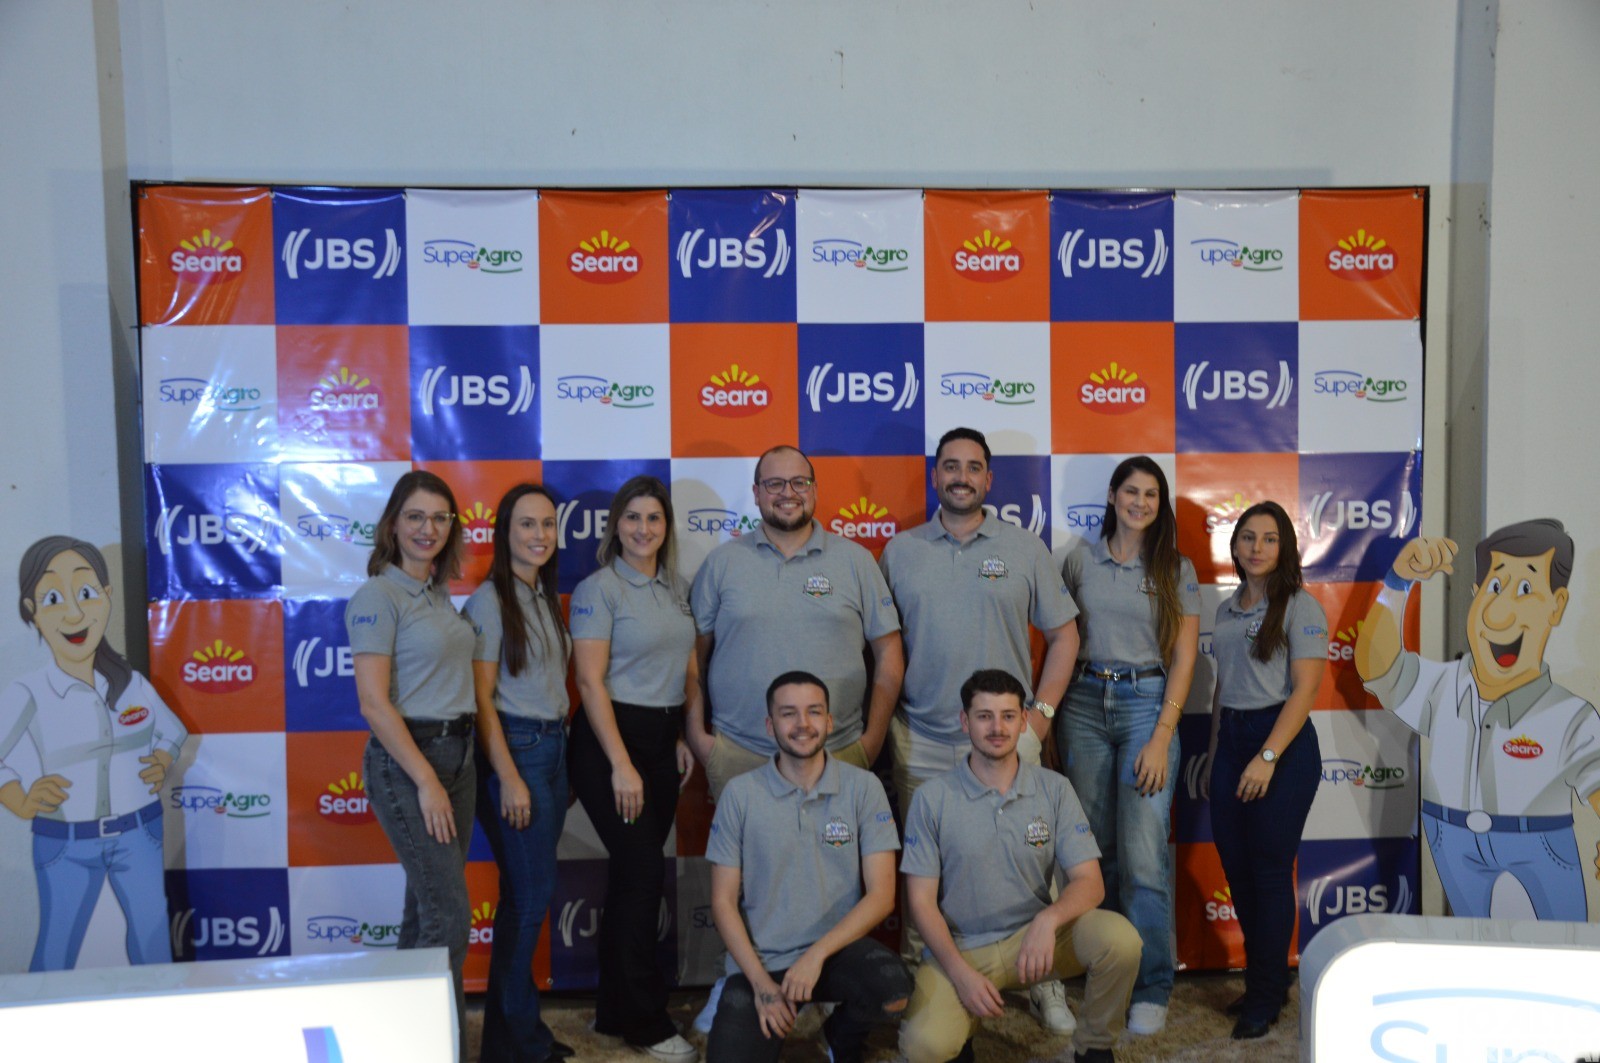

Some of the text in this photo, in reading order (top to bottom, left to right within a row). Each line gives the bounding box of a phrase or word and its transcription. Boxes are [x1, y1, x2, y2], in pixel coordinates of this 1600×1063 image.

[171, 251, 241, 272] Seara
[304, 238, 376, 270] JBS
[423, 246, 523, 267] SuperAgro
[570, 251, 638, 272] Seara
[697, 238, 767, 269] JBS
[812, 246, 908, 267] SuperAgro
[954, 251, 1019, 272] Seara
[1078, 238, 1145, 269] JBS
[1328, 250, 1394, 272] Seara
[160, 384, 261, 406] SupeAgro
[439, 375, 511, 406] JBS
[557, 382, 654, 404] SuperAgro
[826, 371, 895, 403] JBS
[940, 379, 1035, 400] SuperAgro
[1080, 383, 1145, 405] Seara
[1203, 370, 1269, 401] JBS
[1314, 377, 1407, 398] SuperAgro
[310, 390, 379, 411] Seara
[701, 386, 767, 407] Seara
[1326, 499, 1393, 531] JBS
[177, 514, 249, 545] JBS
[297, 520, 376, 541] SuperAg
[462, 527, 495, 544] ear
[830, 518, 896, 538] Seara
[183, 661, 253, 682] Seara
[1504, 743, 1541, 755] Seara
[1321, 765, 1404, 785] uperAgro
[171, 792, 271, 813] SuperAgro
[319, 794, 370, 815] Sear
[1325, 884, 1389, 915] JBS
[190, 916, 261, 947] JBS
